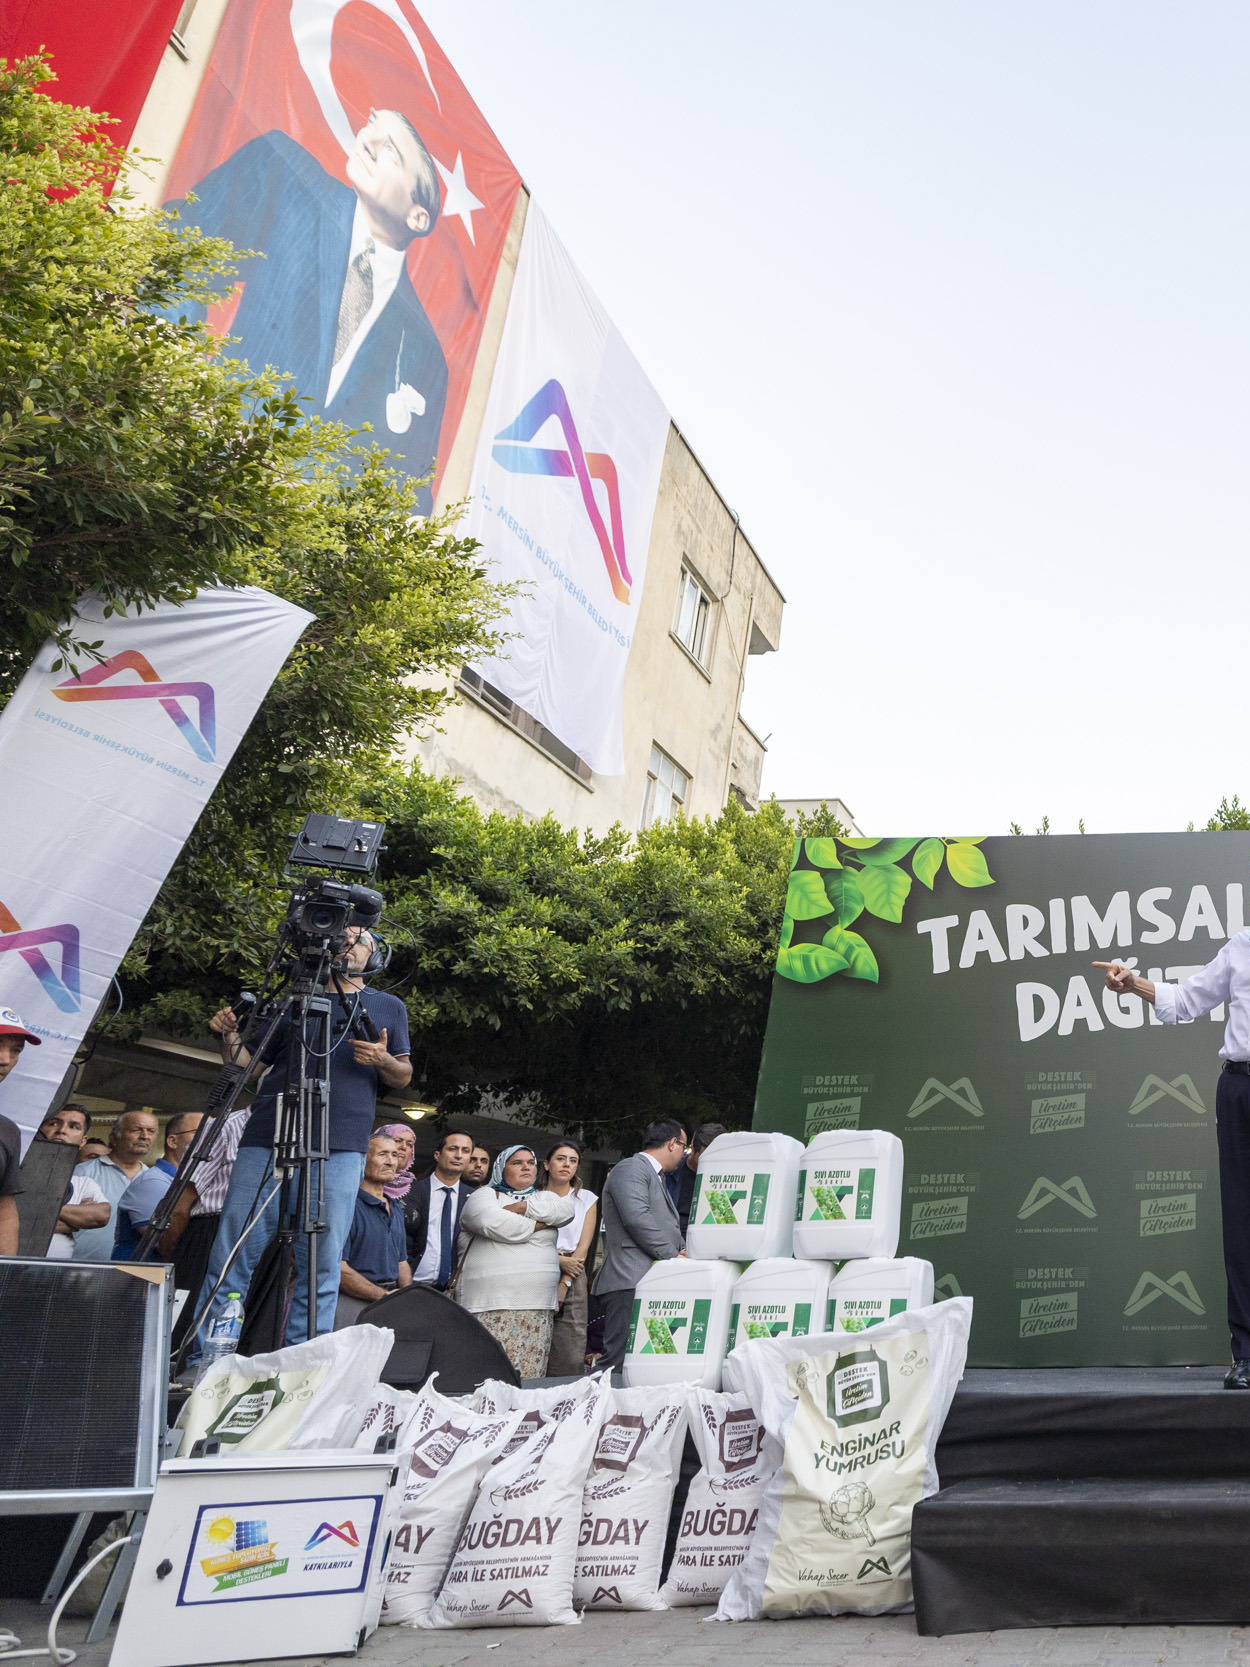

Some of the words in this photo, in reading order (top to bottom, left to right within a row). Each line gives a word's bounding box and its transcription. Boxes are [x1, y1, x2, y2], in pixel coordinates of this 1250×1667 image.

[497, 505, 535, 552] MERSİN
[535, 546, 588, 610] BÜYÜKŞEHİR
[816, 1075, 859, 1086] DESTEK
[1038, 1071, 1082, 1082] DESTEK
[813, 1102, 854, 1118] Üretim
[1038, 1099, 1078, 1114] Üretim
[1032, 1115, 1084, 1134] Çiftçiden
[709, 1175, 722, 1183] SIVI
[723, 1175, 746, 1183] AZOTLU
[814, 1171, 827, 1179] SIVI
[828, 1170, 851, 1179] AZOTLU
[920, 1173, 966, 1184] DESTEK
[919, 1203, 960, 1219] Üretim
[912, 1219, 966, 1239] Çiftçiden
[1027, 1268, 1074, 1279] DESTEK
[648, 1301, 662, 1310] SIVI
[662, 1301, 687, 1310] AZOTLU
[748, 1305, 761, 1314] SIVI
[762, 1305, 787, 1314] AZOTLU
[843, 1301, 857, 1310] SIVI
[858, 1301, 882, 1309] AZOTLU
[1028, 1298, 1070, 1316] Üretim
[1022, 1316, 1076, 1337] Çiftçiden
[843, 1366, 868, 1378] DESTEK
[845, 1383, 869, 1398] Üretim
[820, 1420, 901, 1458] ENGİNAR
[814, 1440, 906, 1475] YUMRUSU
[680, 1502, 760, 1538] BUĞDA
[459, 1513, 563, 1552] BUĞDAY
[578, 1512, 650, 1547] ĞDAY
[303, 1560, 354, 1572] KATKILARIYLA
[471, 1566, 487, 1582] İLE
[489, 1564, 550, 1581] SATILMAZ
[581, 1564, 637, 1578] SATILMAZ
[798, 1567, 826, 1587] Vahap
[677, 1581, 700, 1598] Vahap
